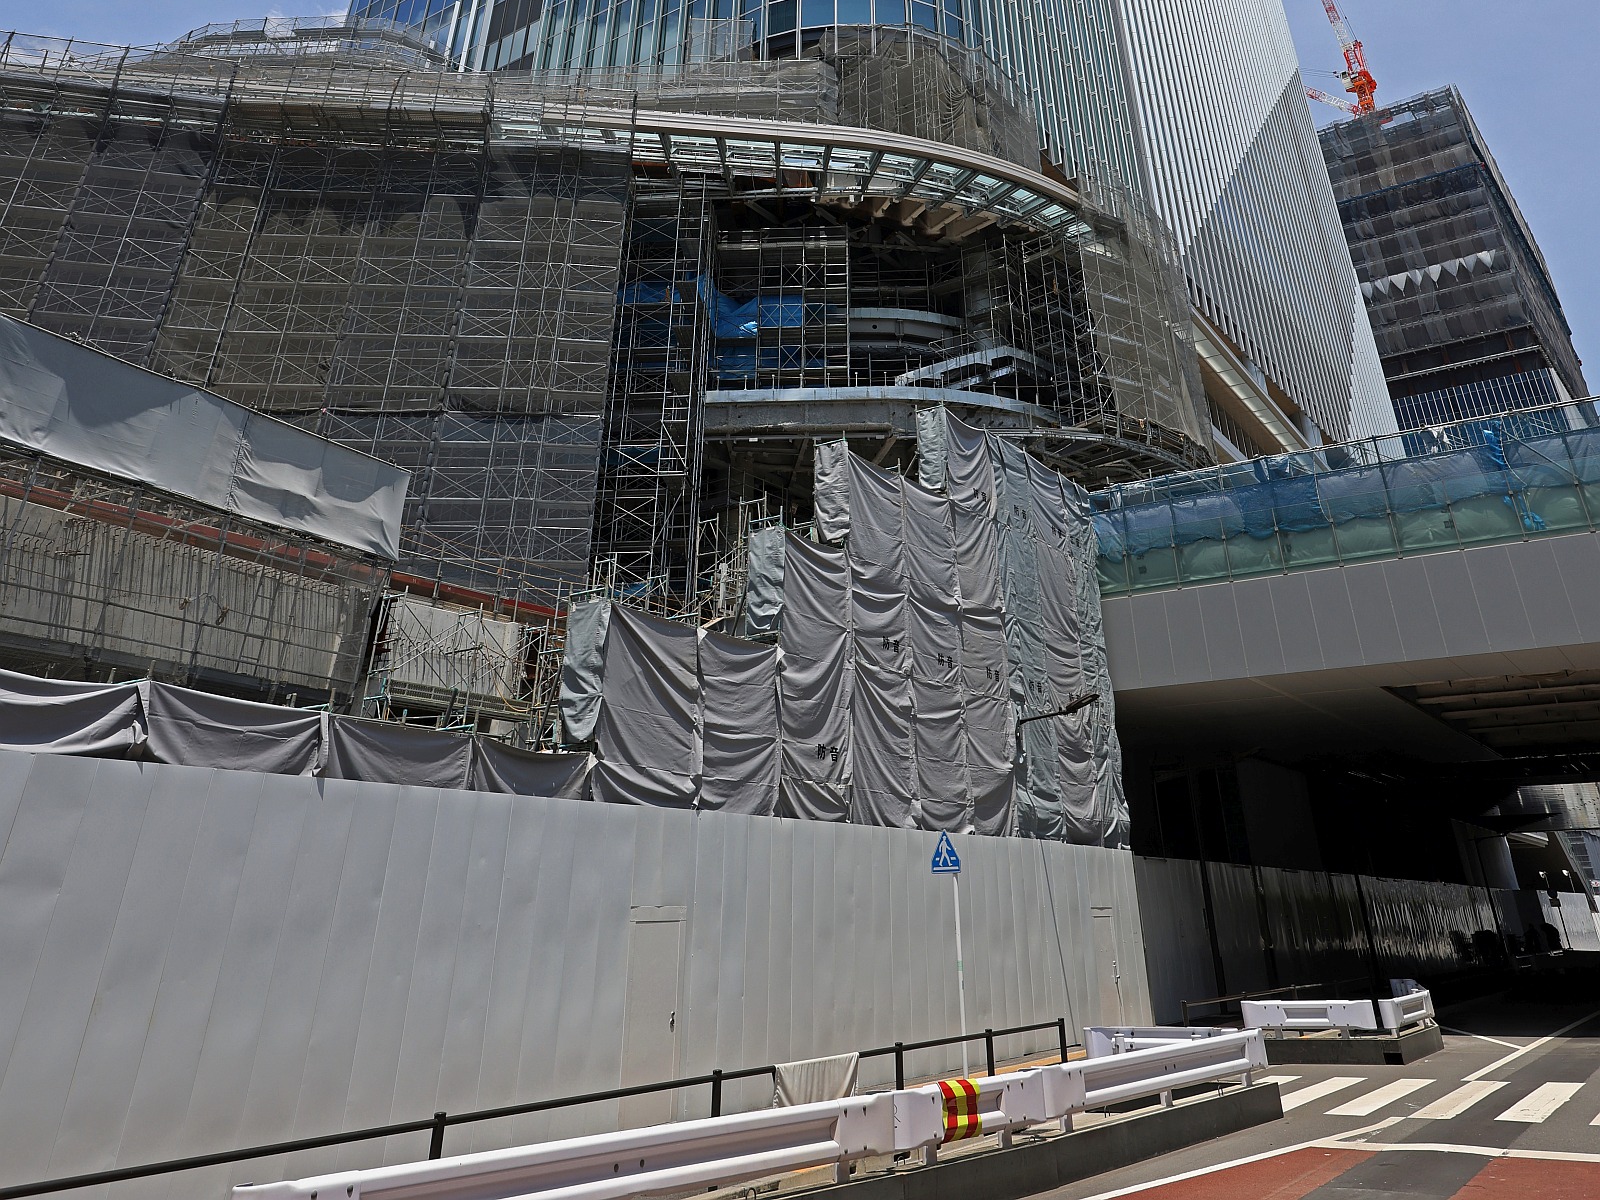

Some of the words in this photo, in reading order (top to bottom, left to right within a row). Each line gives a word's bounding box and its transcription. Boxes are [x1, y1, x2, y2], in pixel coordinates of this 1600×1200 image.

[882, 636, 900, 653] 防音
[937, 653, 953, 669] 防音
[817, 743, 839, 762] 防音
